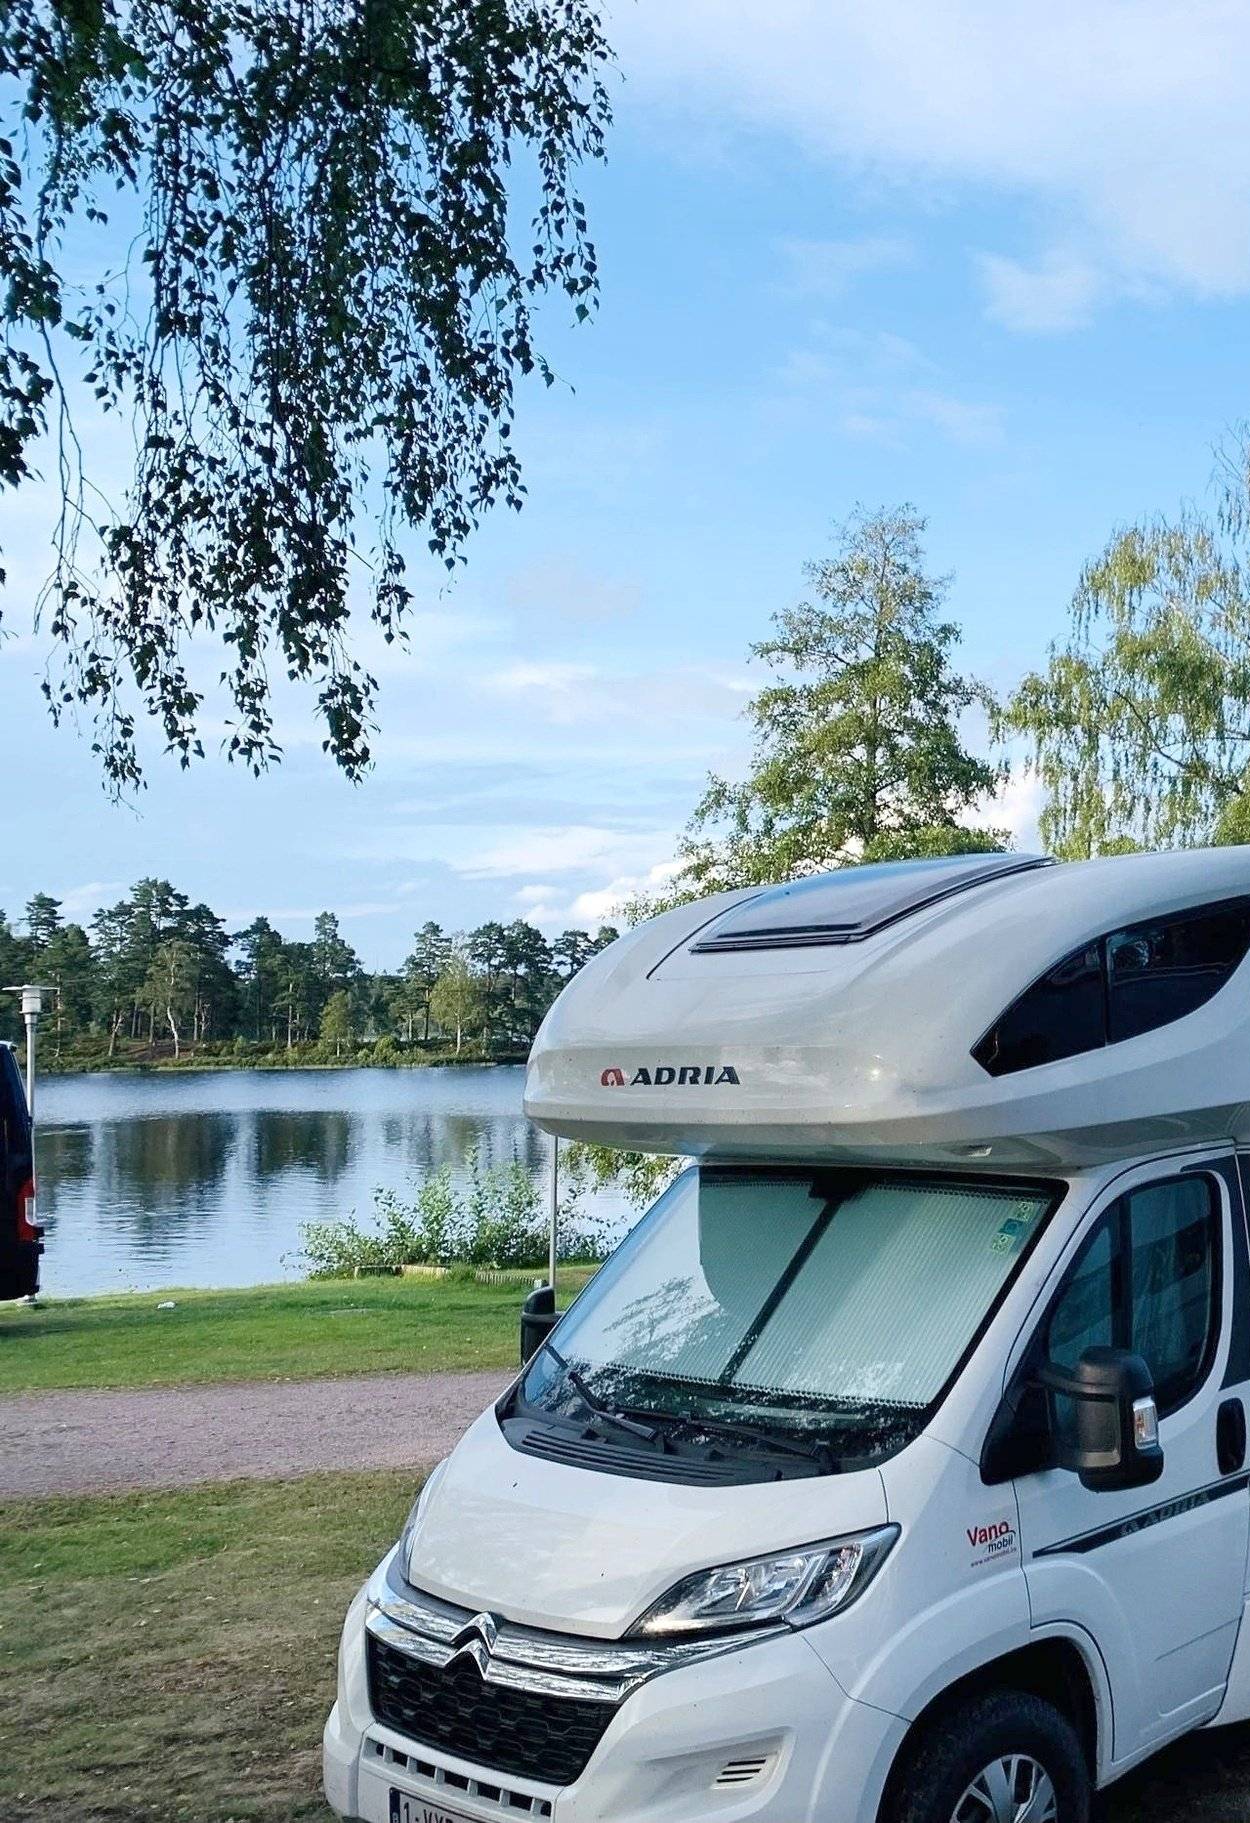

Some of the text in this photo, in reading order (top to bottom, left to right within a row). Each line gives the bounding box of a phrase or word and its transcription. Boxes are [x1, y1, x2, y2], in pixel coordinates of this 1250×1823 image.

[630, 1066, 740, 1086] ADRIA
[966, 1520, 1010, 1548] Vano
[987, 1533, 1014, 1554] mobil
